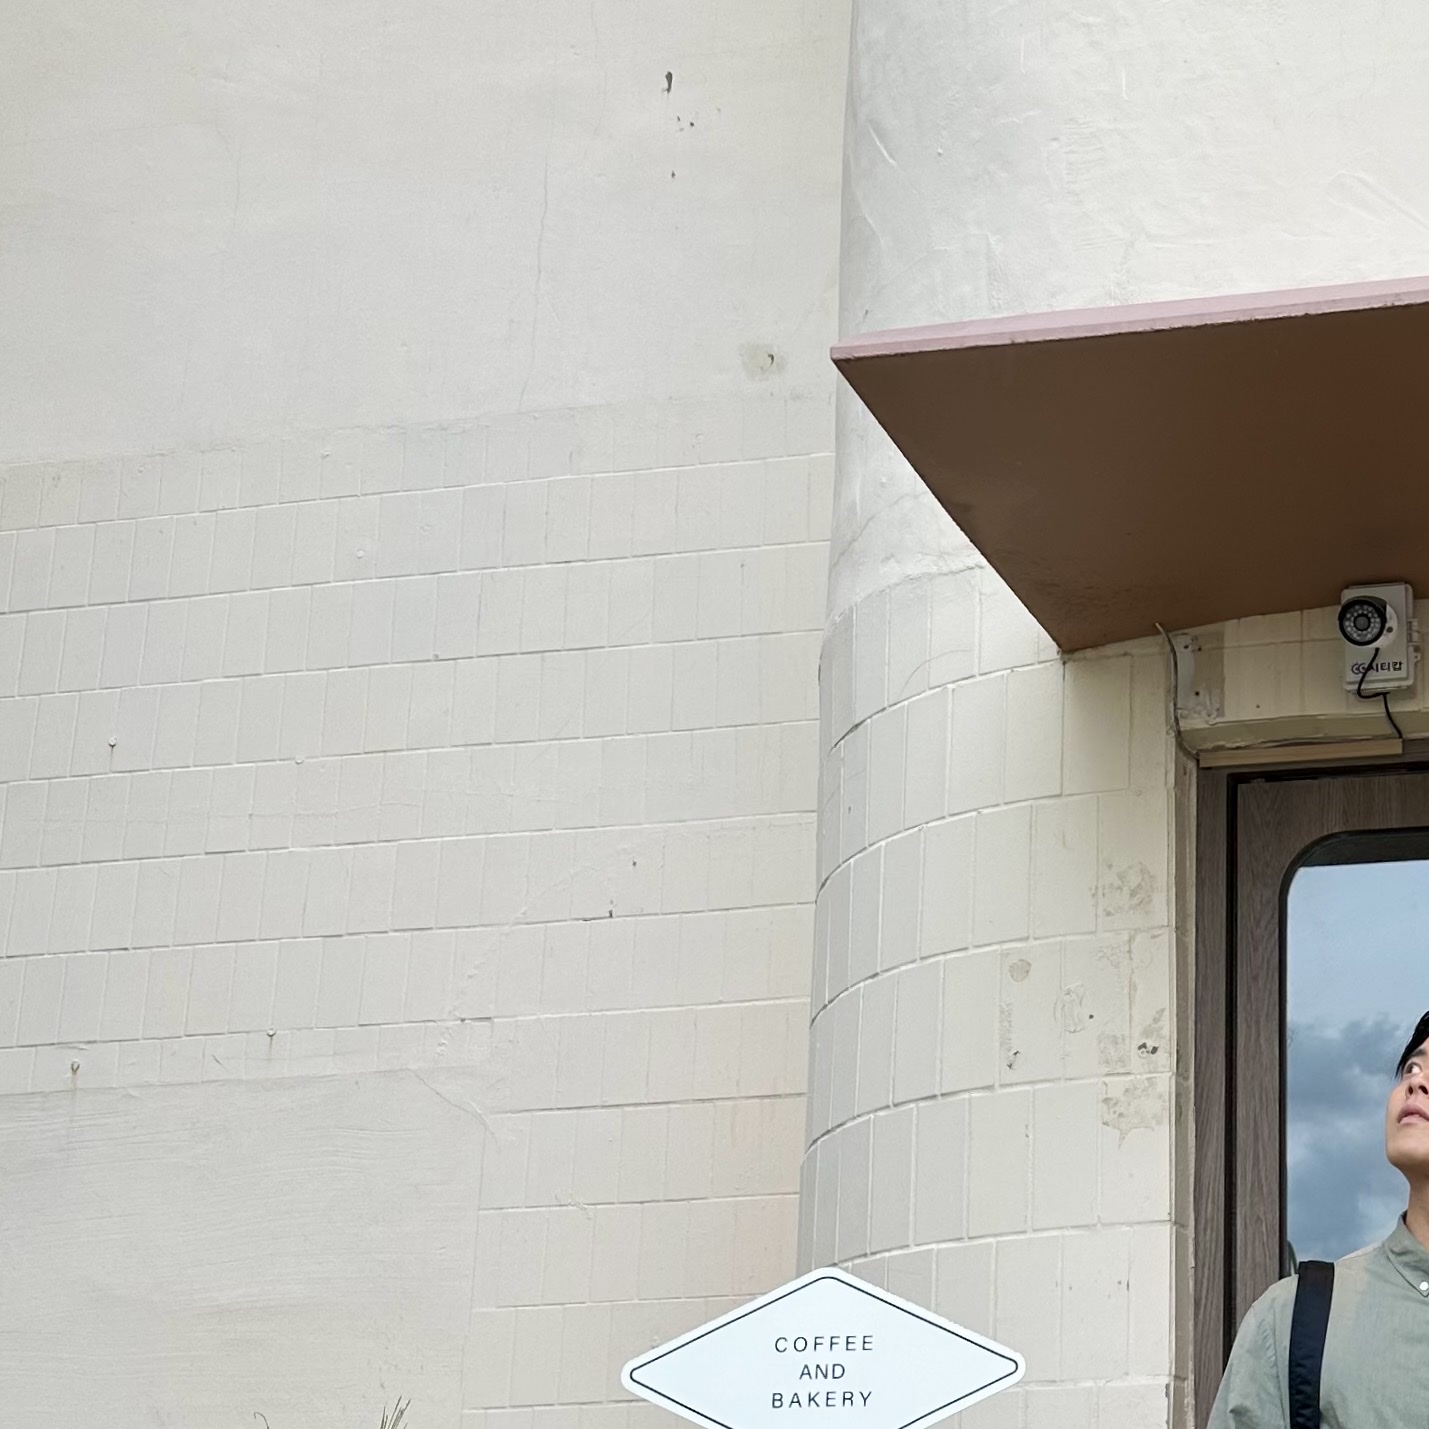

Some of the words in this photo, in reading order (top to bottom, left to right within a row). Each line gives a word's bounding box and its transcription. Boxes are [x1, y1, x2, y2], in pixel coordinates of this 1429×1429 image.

[774, 1334, 874, 1354] COFFEE
[798, 1363, 846, 1381] AND
[771, 1390, 873, 1409] BAKERY
